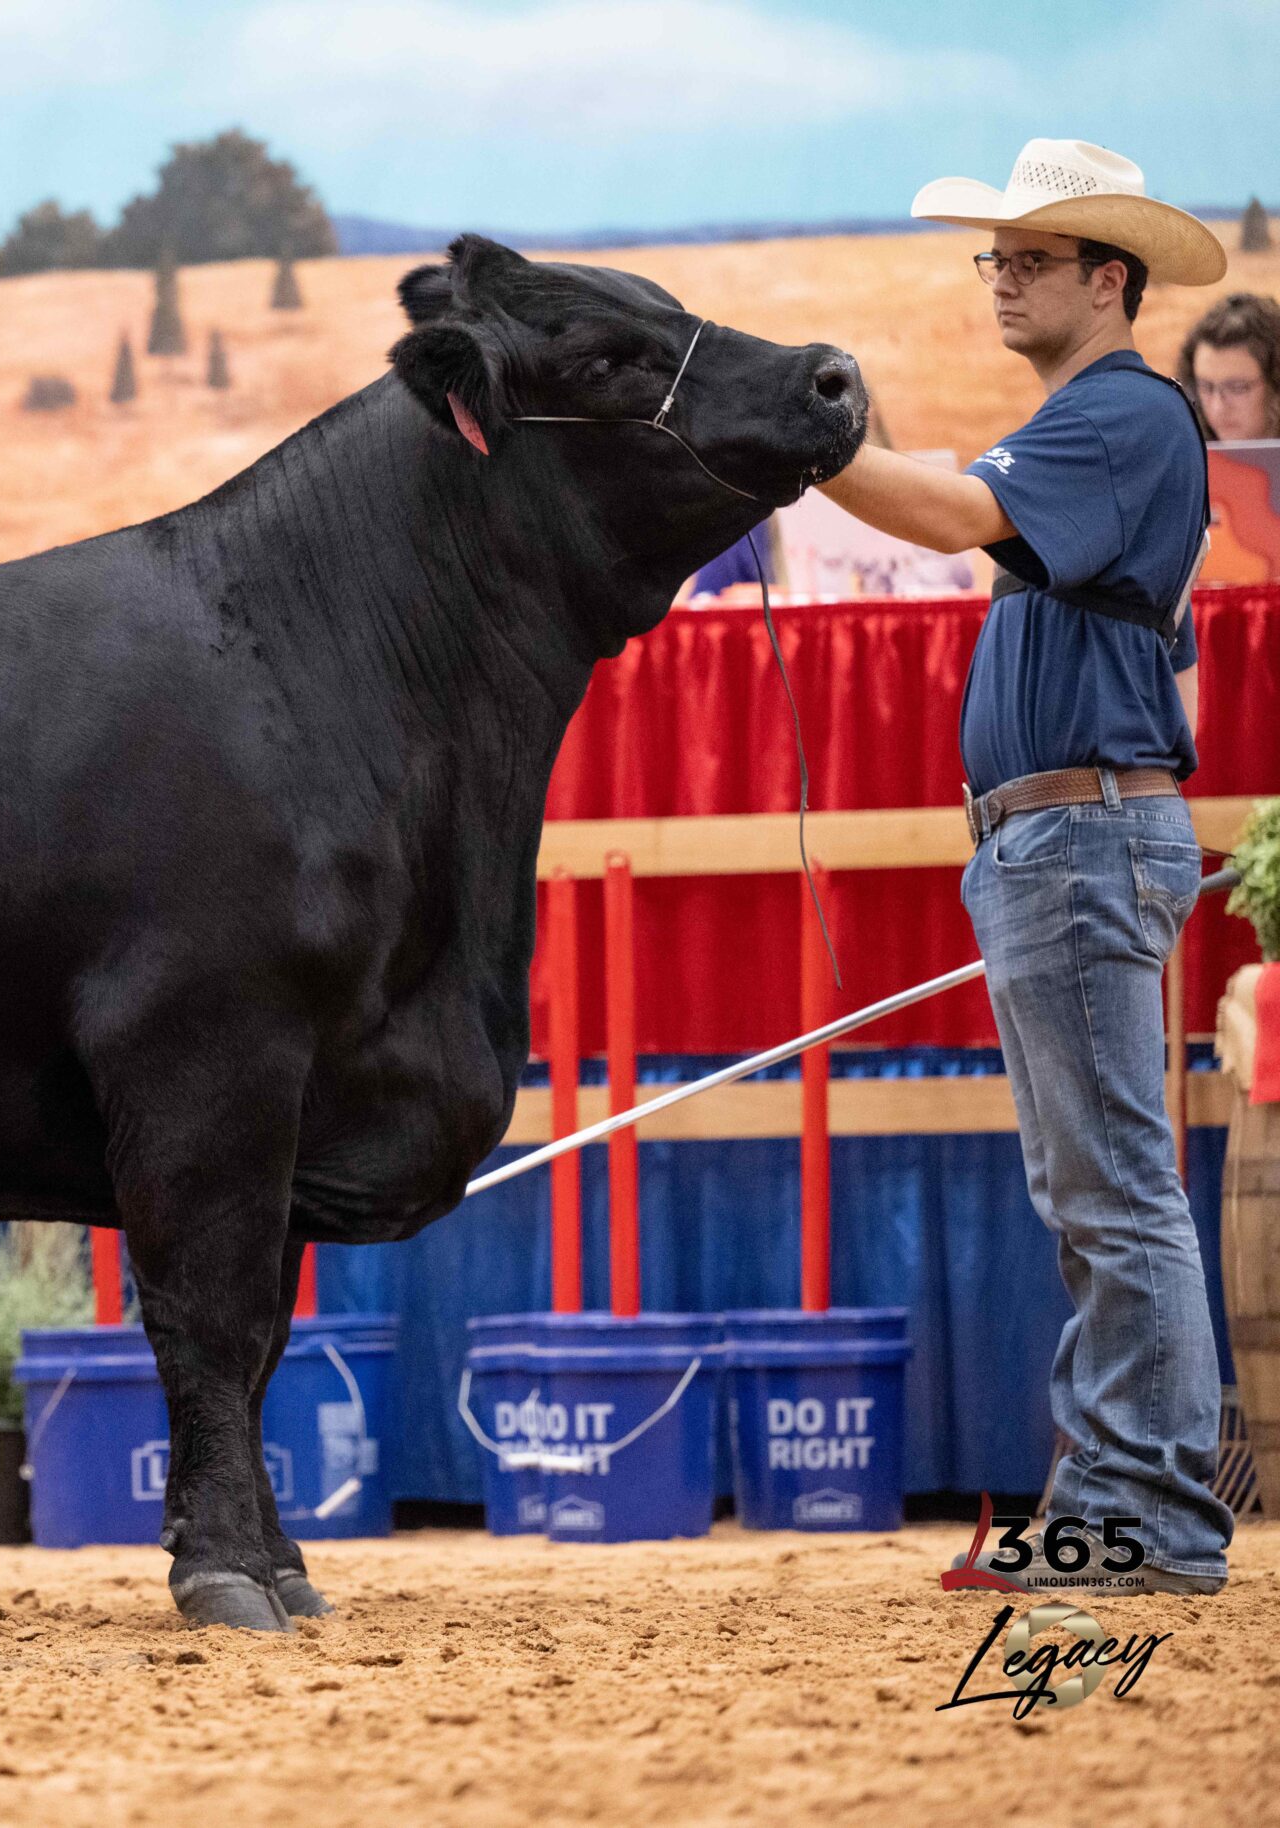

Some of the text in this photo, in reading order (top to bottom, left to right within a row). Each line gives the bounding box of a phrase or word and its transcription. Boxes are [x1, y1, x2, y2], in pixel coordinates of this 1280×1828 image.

[575, 1403, 615, 1441] IT
[767, 1397, 875, 1436] DO IT
[768, 1436, 875, 1471] RIGHT
